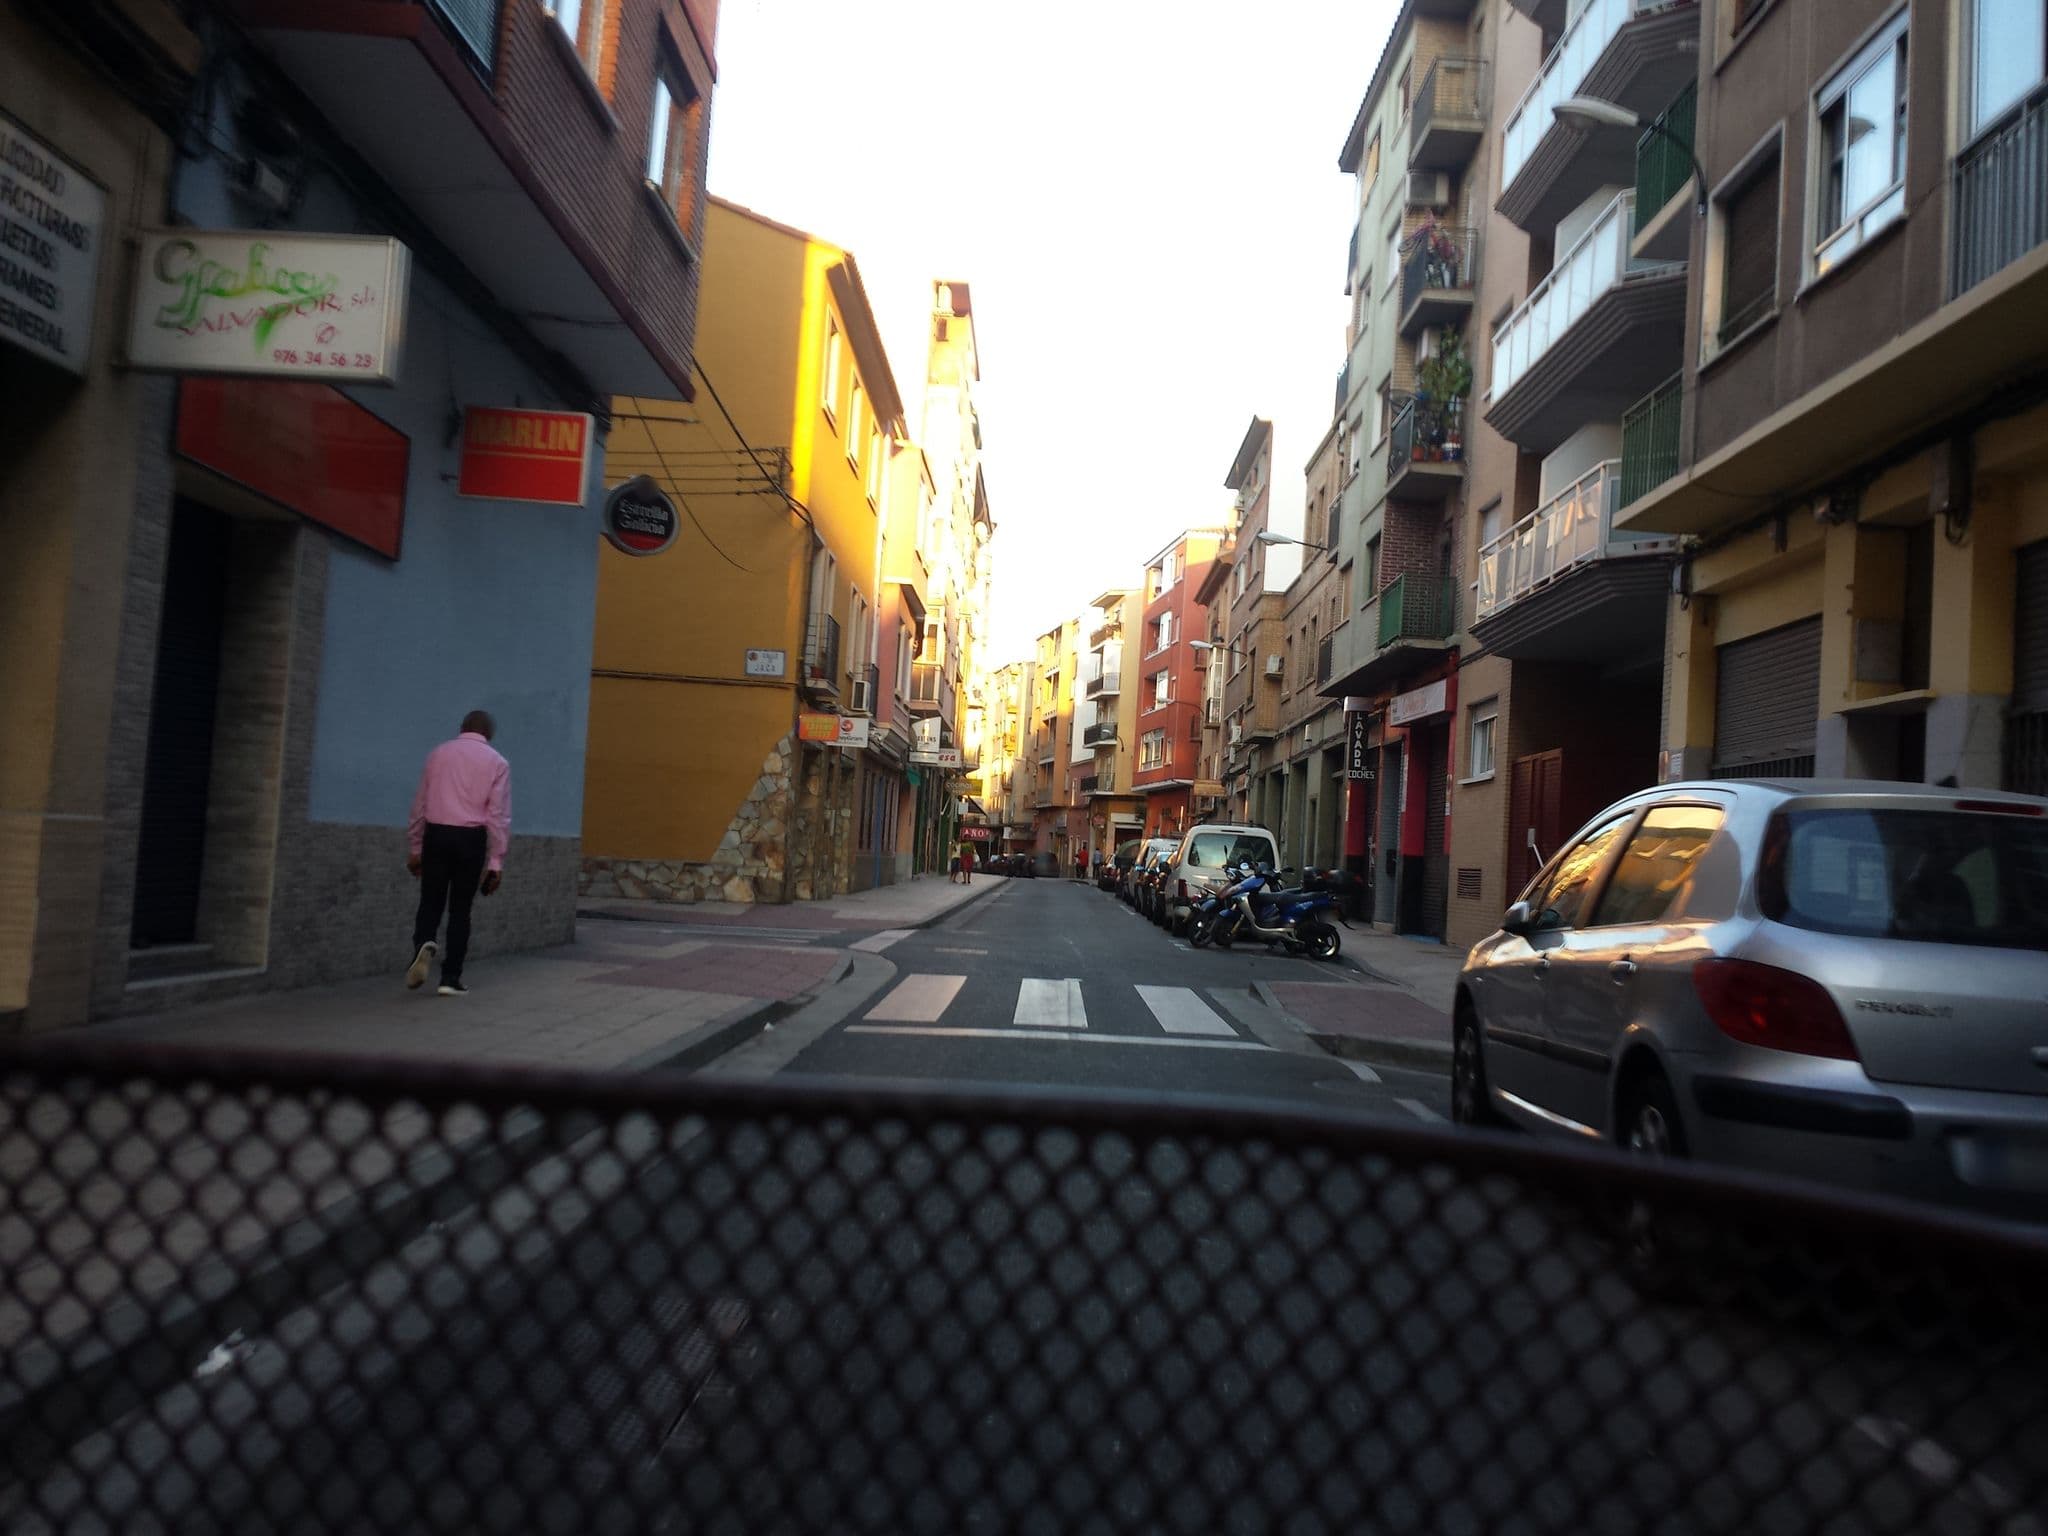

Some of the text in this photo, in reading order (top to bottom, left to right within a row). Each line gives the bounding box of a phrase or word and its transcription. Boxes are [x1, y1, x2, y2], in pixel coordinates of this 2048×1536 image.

[273, 349, 373, 368] 976 34 56 23
[1353, 711, 1364, 768] LAVADO
[1348, 769, 1376, 780] COCHES
